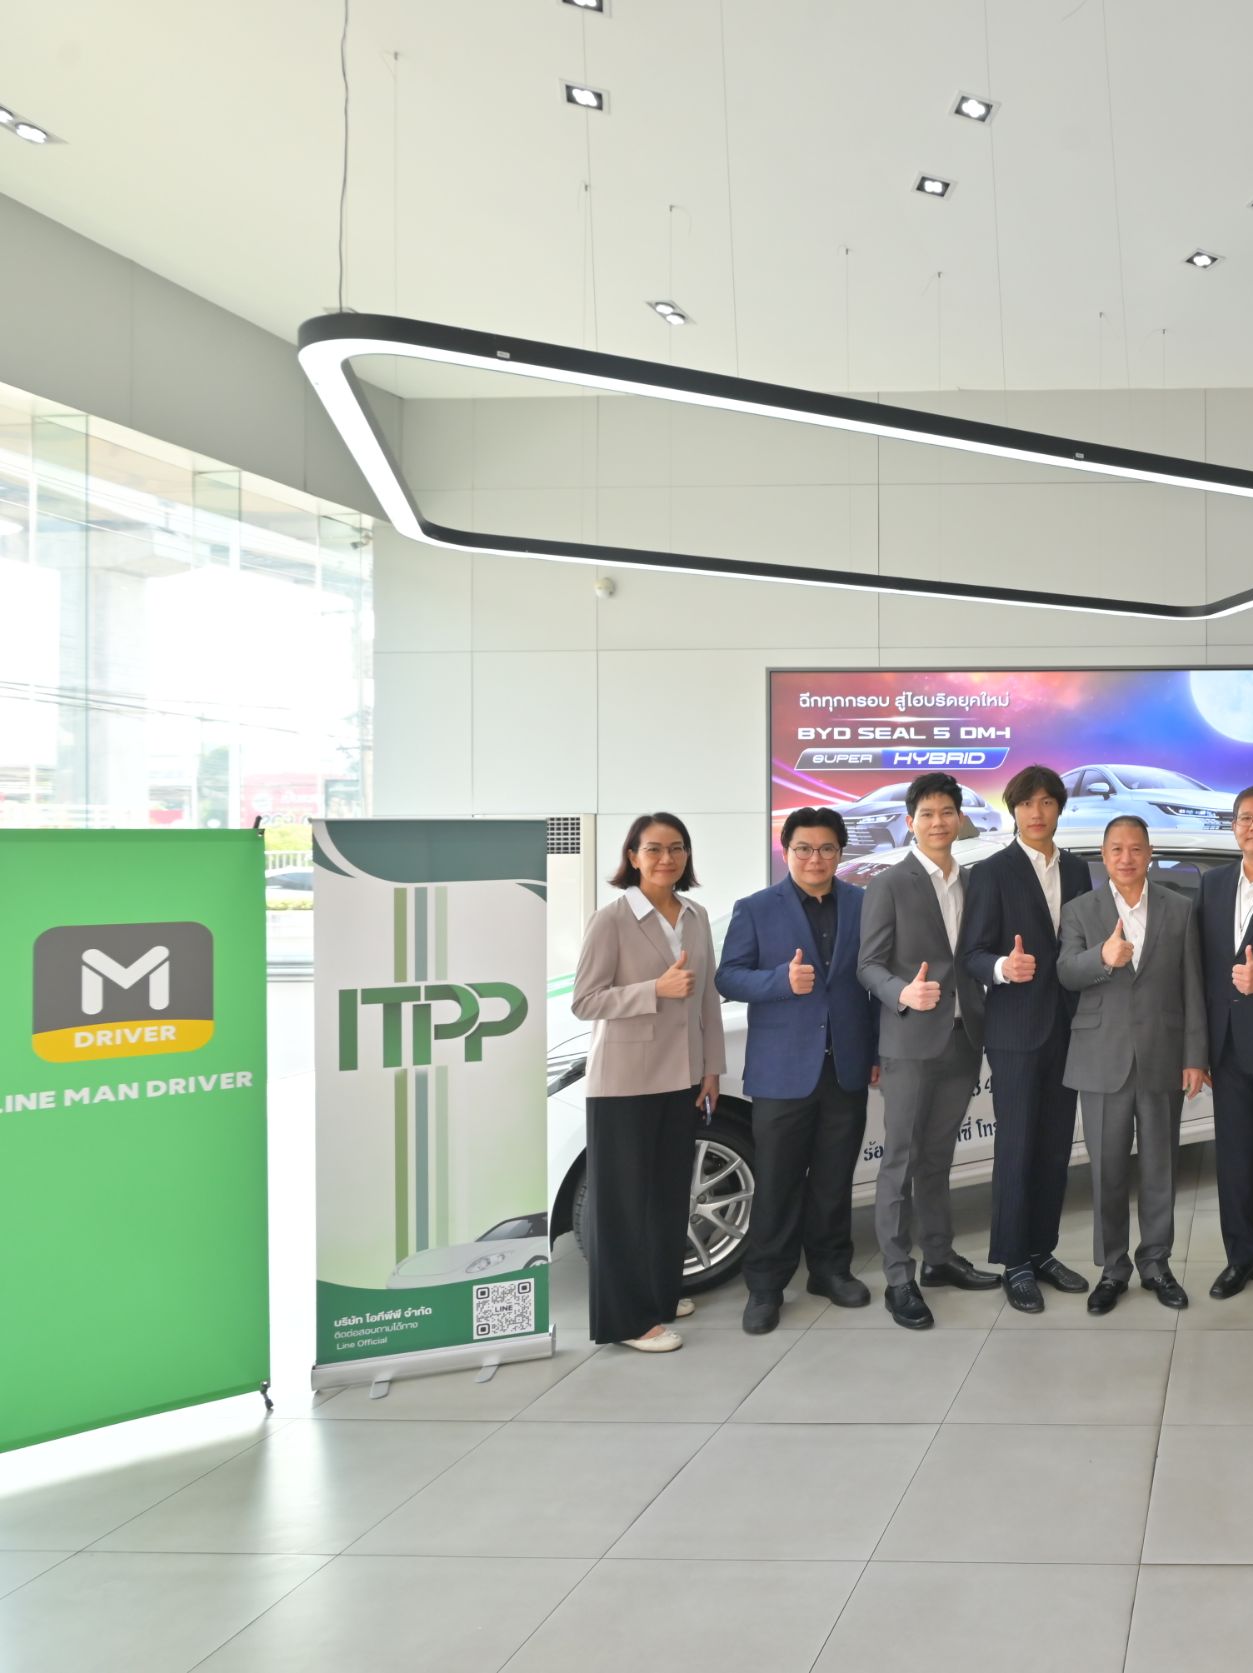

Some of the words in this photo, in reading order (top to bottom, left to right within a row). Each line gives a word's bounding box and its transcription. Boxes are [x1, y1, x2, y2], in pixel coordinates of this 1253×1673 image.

[799, 691, 890, 712] ฉีกทุกกรอบ
[894, 691, 1010, 712] สู่ไฮบริดยุคใหม่
[797, 727, 851, 740] BYD
[858, 727, 927, 740] SEAL
[933, 727, 951, 740] 5
[812, 754, 873, 764] SUPER
[893, 752, 986, 765] HYBRID
[74, 1024, 177, 1049] DRIVER
[338, 981, 529, 1072] ITPP
[0, 1091, 57, 1114] INE
[63, 1082, 139, 1107] MAN
[146, 1070, 253, 1098] DRIVER
[333, 1314, 363, 1328] บริษัท
[366, 1308, 401, 1324] โอทีพีพี
[404, 1305, 433, 1318] จำกัด
[494, 1303, 514, 1313] LINE
[336, 1341, 355, 1350] Line
[357, 1337, 388, 1348] Official
